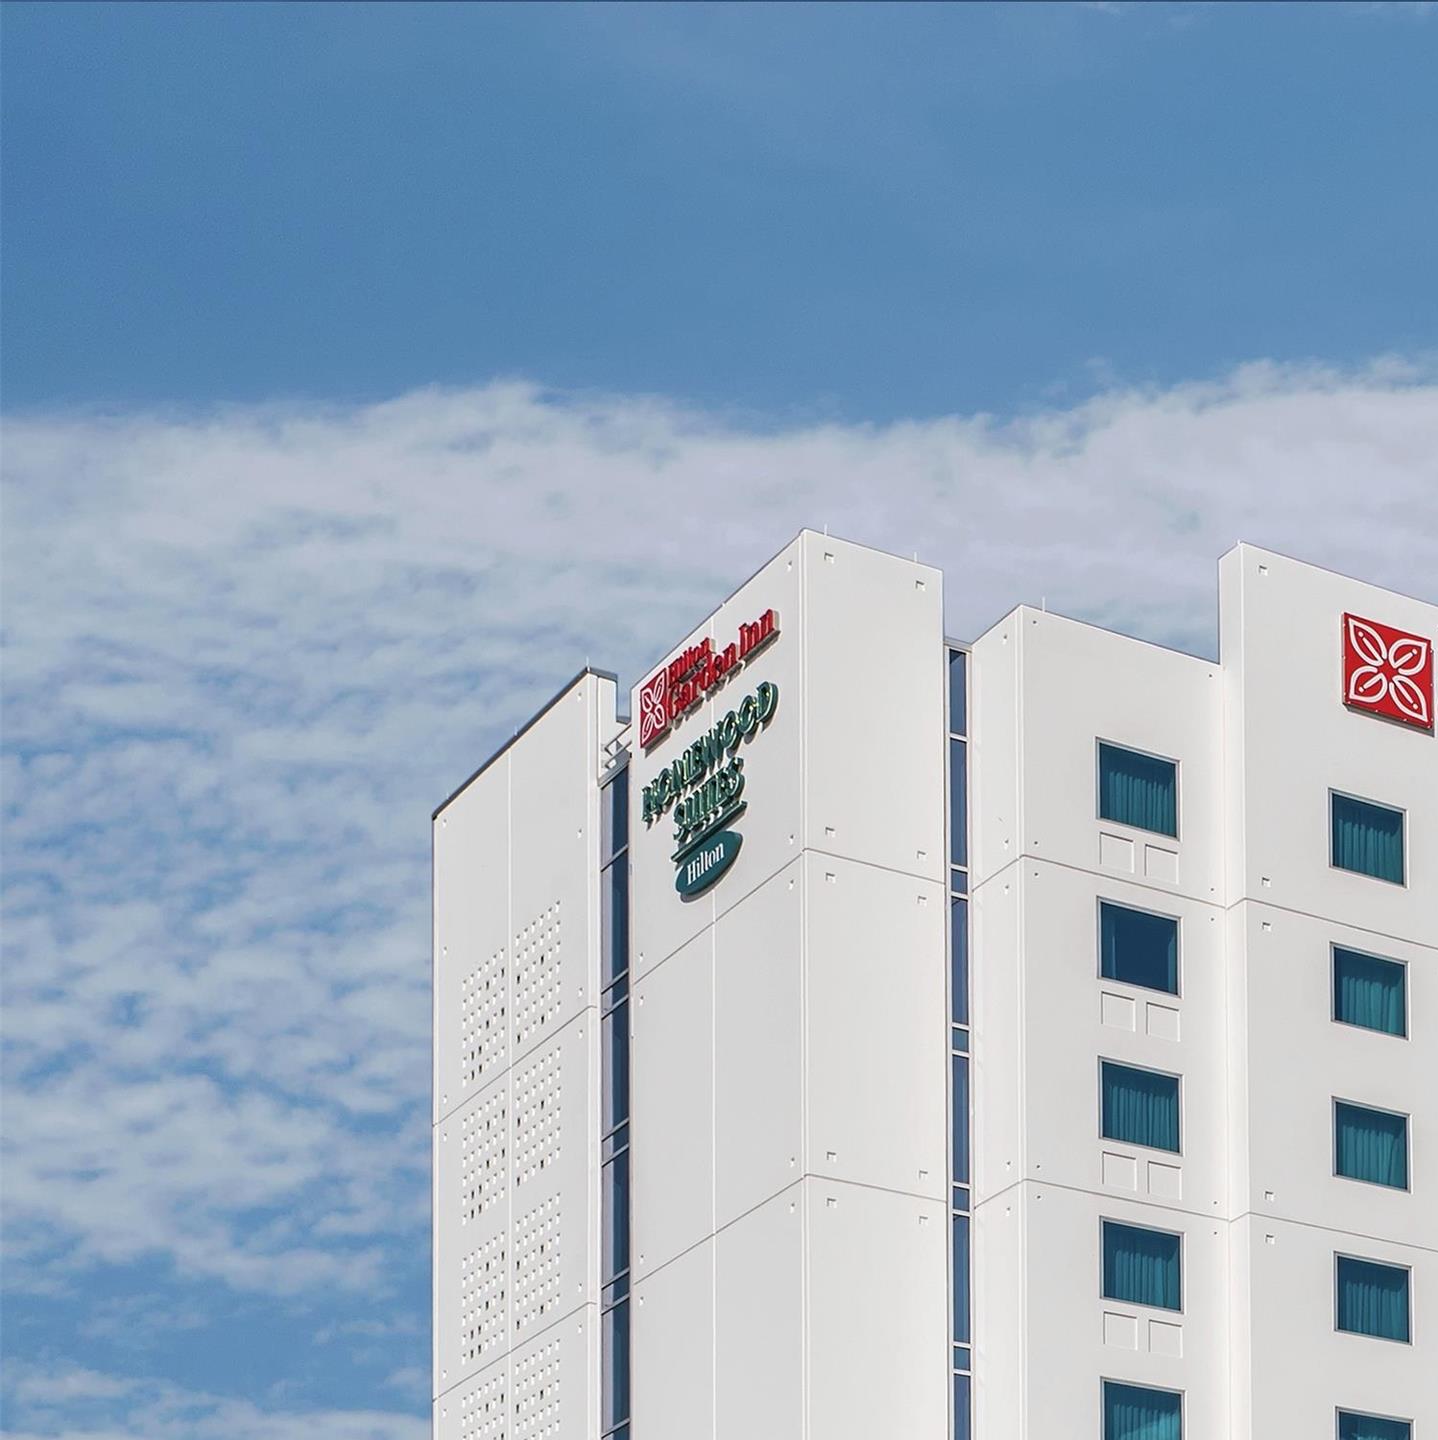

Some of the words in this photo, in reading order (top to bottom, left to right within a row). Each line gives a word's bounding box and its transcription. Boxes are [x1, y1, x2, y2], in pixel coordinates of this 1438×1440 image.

[739, 608, 775, 660] Inn
[641, 681, 779, 822] HOMEWOOD
[673, 756, 745, 842] SUITES
[686, 843, 725, 886] Hilton
